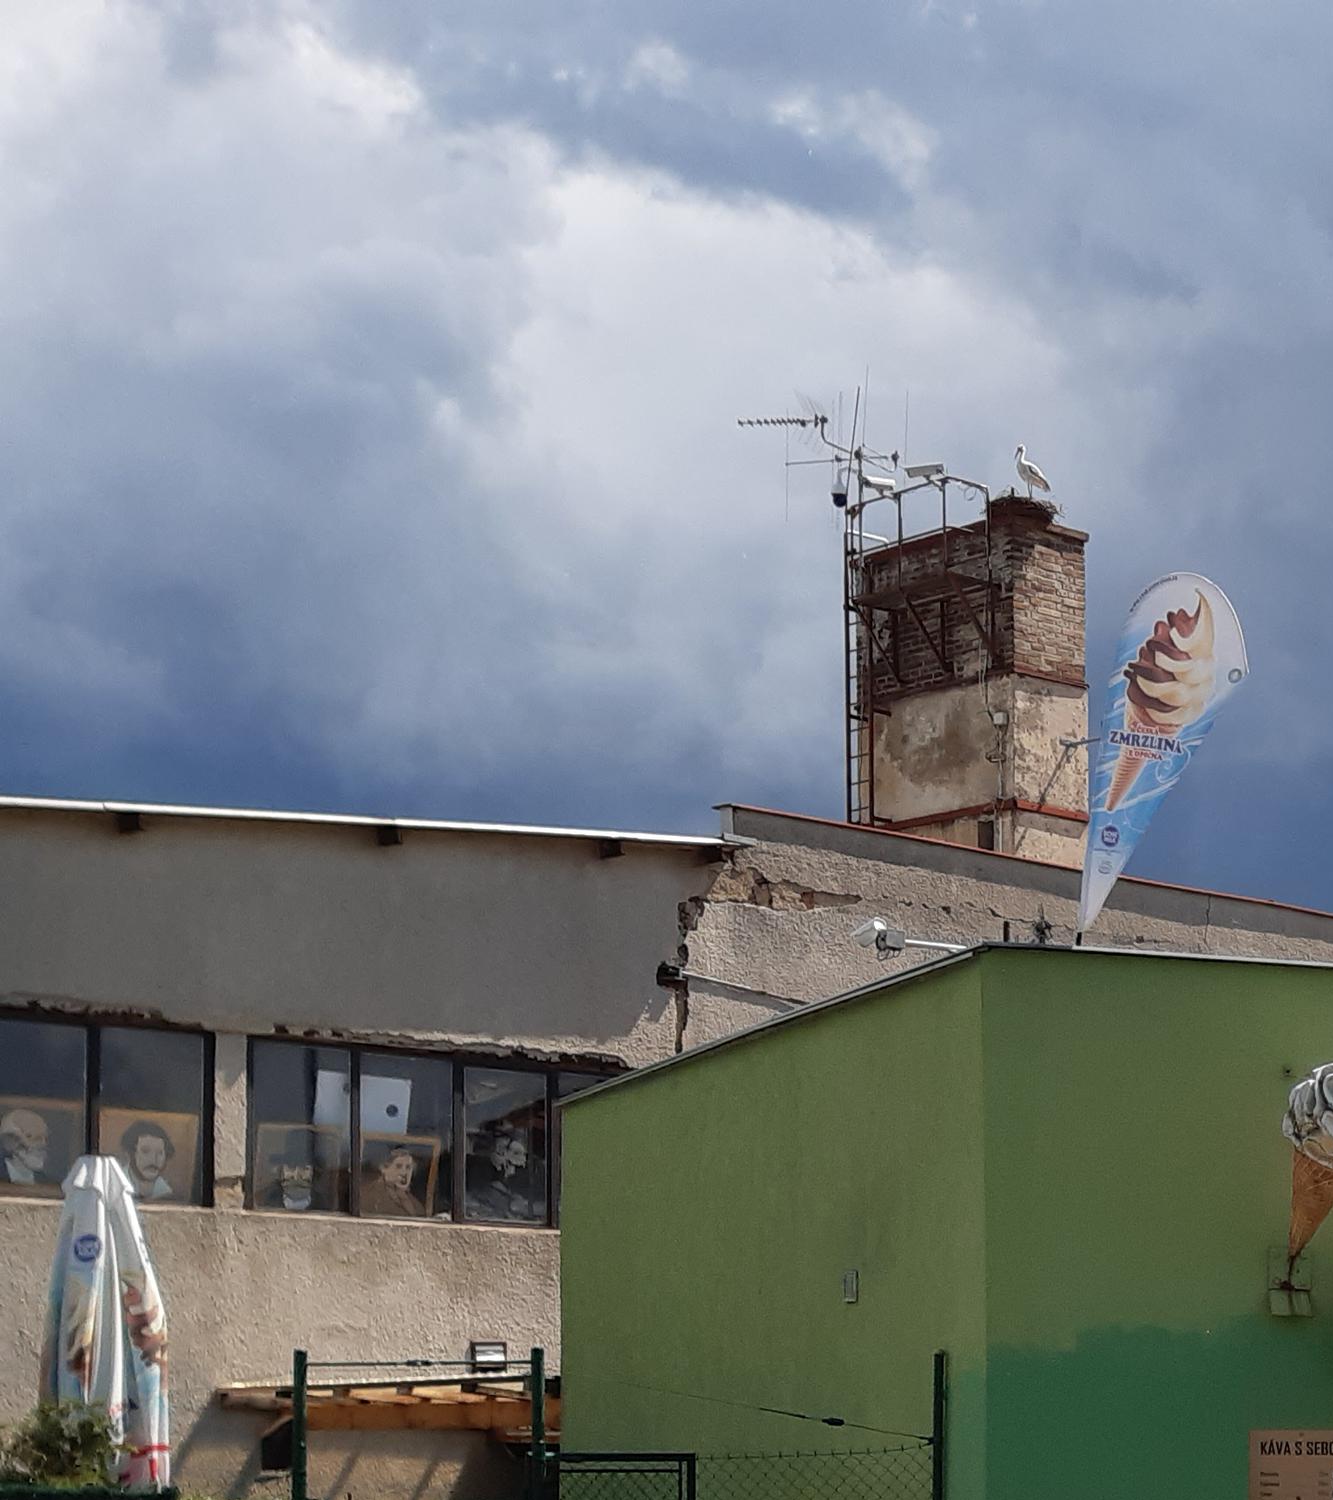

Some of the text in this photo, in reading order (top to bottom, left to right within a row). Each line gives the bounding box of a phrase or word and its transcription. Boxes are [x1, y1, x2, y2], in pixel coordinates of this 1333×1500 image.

[1109, 730, 1182, 754] ZMRZLINA
[1260, 1439, 1292, 1456] KÁVA
[1294, 1441, 1303, 1456] S
